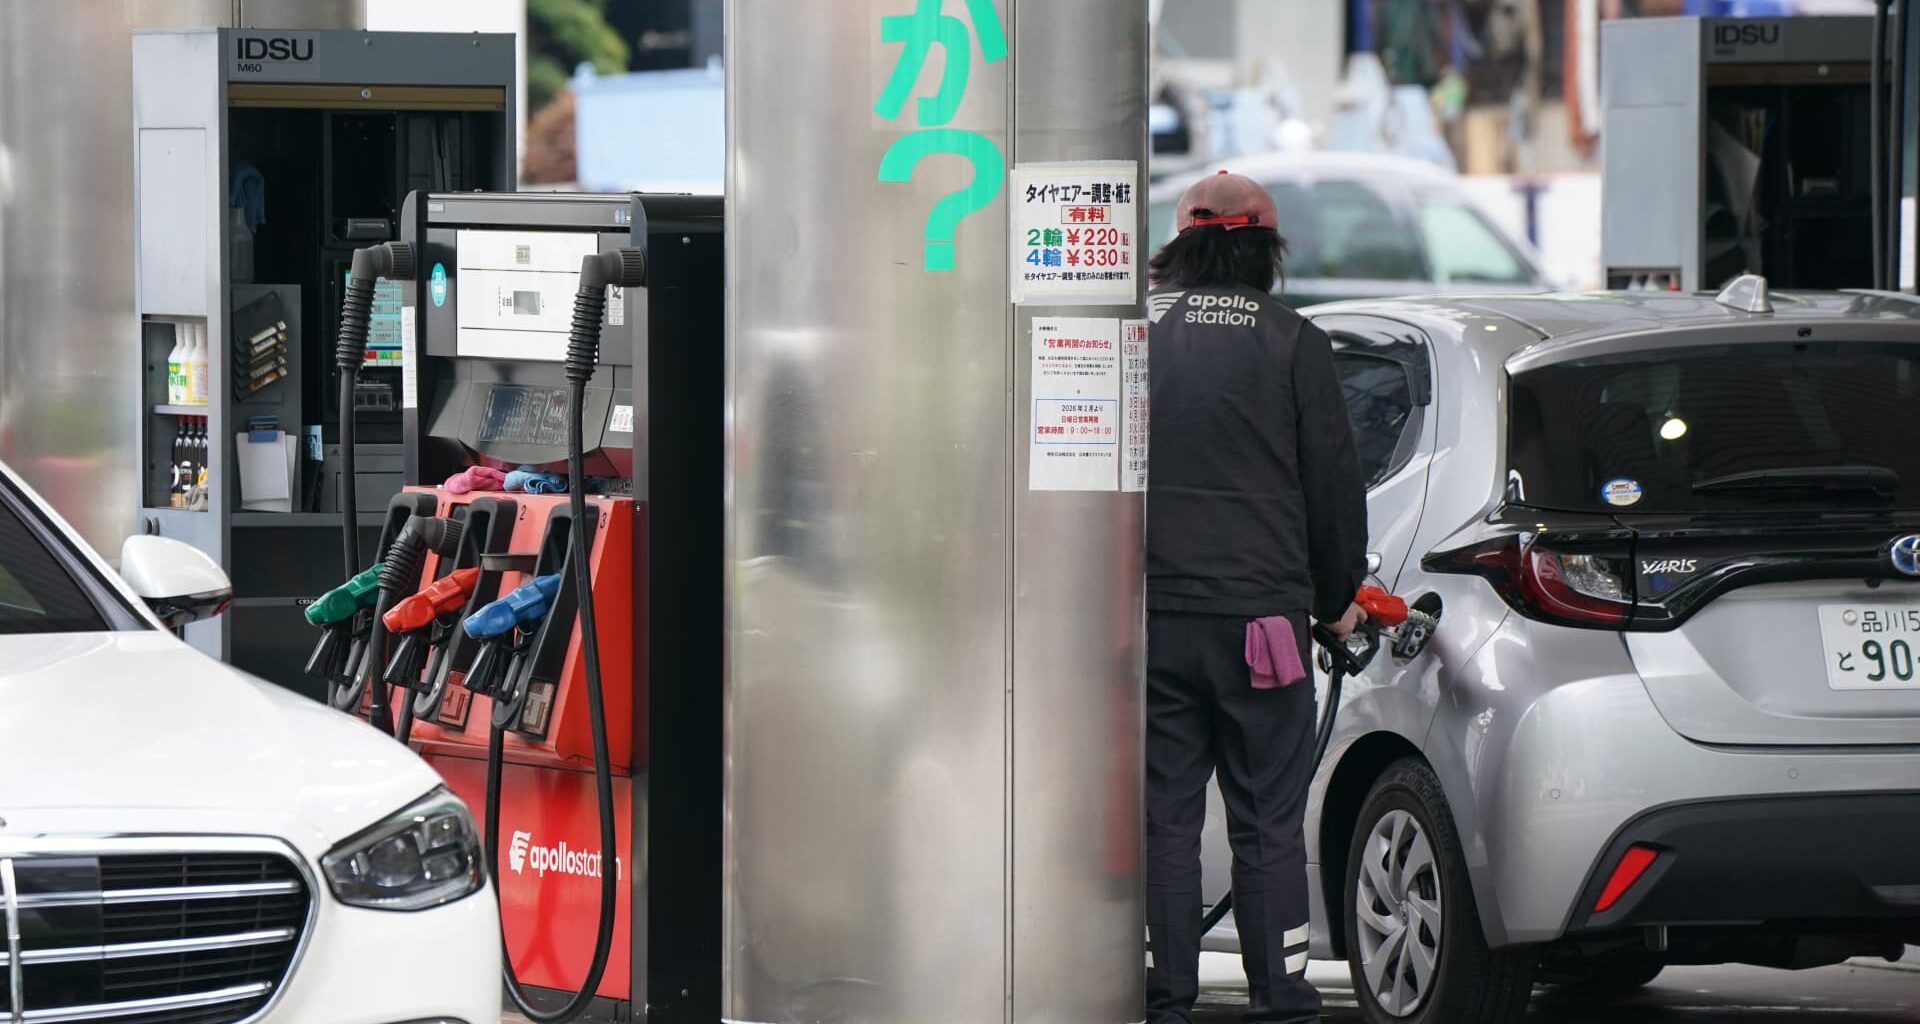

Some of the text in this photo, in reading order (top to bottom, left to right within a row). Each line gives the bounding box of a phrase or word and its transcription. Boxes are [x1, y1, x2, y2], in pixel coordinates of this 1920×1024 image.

[1714, 25, 1780, 44] IDSU
[237, 38, 314, 61] IDSU
[237, 63, 262, 73] M60
[1026, 184, 1131, 203] タイヤエアー調整・補充
[1068, 207, 1105, 222] 有料
[1027, 228, 1063, 247] 2輪
[1067, 228, 1118, 246] ¥220
[1026, 248, 1062, 267] 4輪
[1067, 249, 1118, 266] ¥330
[1187, 294, 1260, 312] apollo
[1185, 310, 1256, 327] station
[519, 504, 527, 521] 2
[599, 512, 607, 529] 3
[1641, 558, 1697, 575] YARIS
[1836, 639, 1920, 682] と 90
[530, 841, 621, 881] apollostatn
